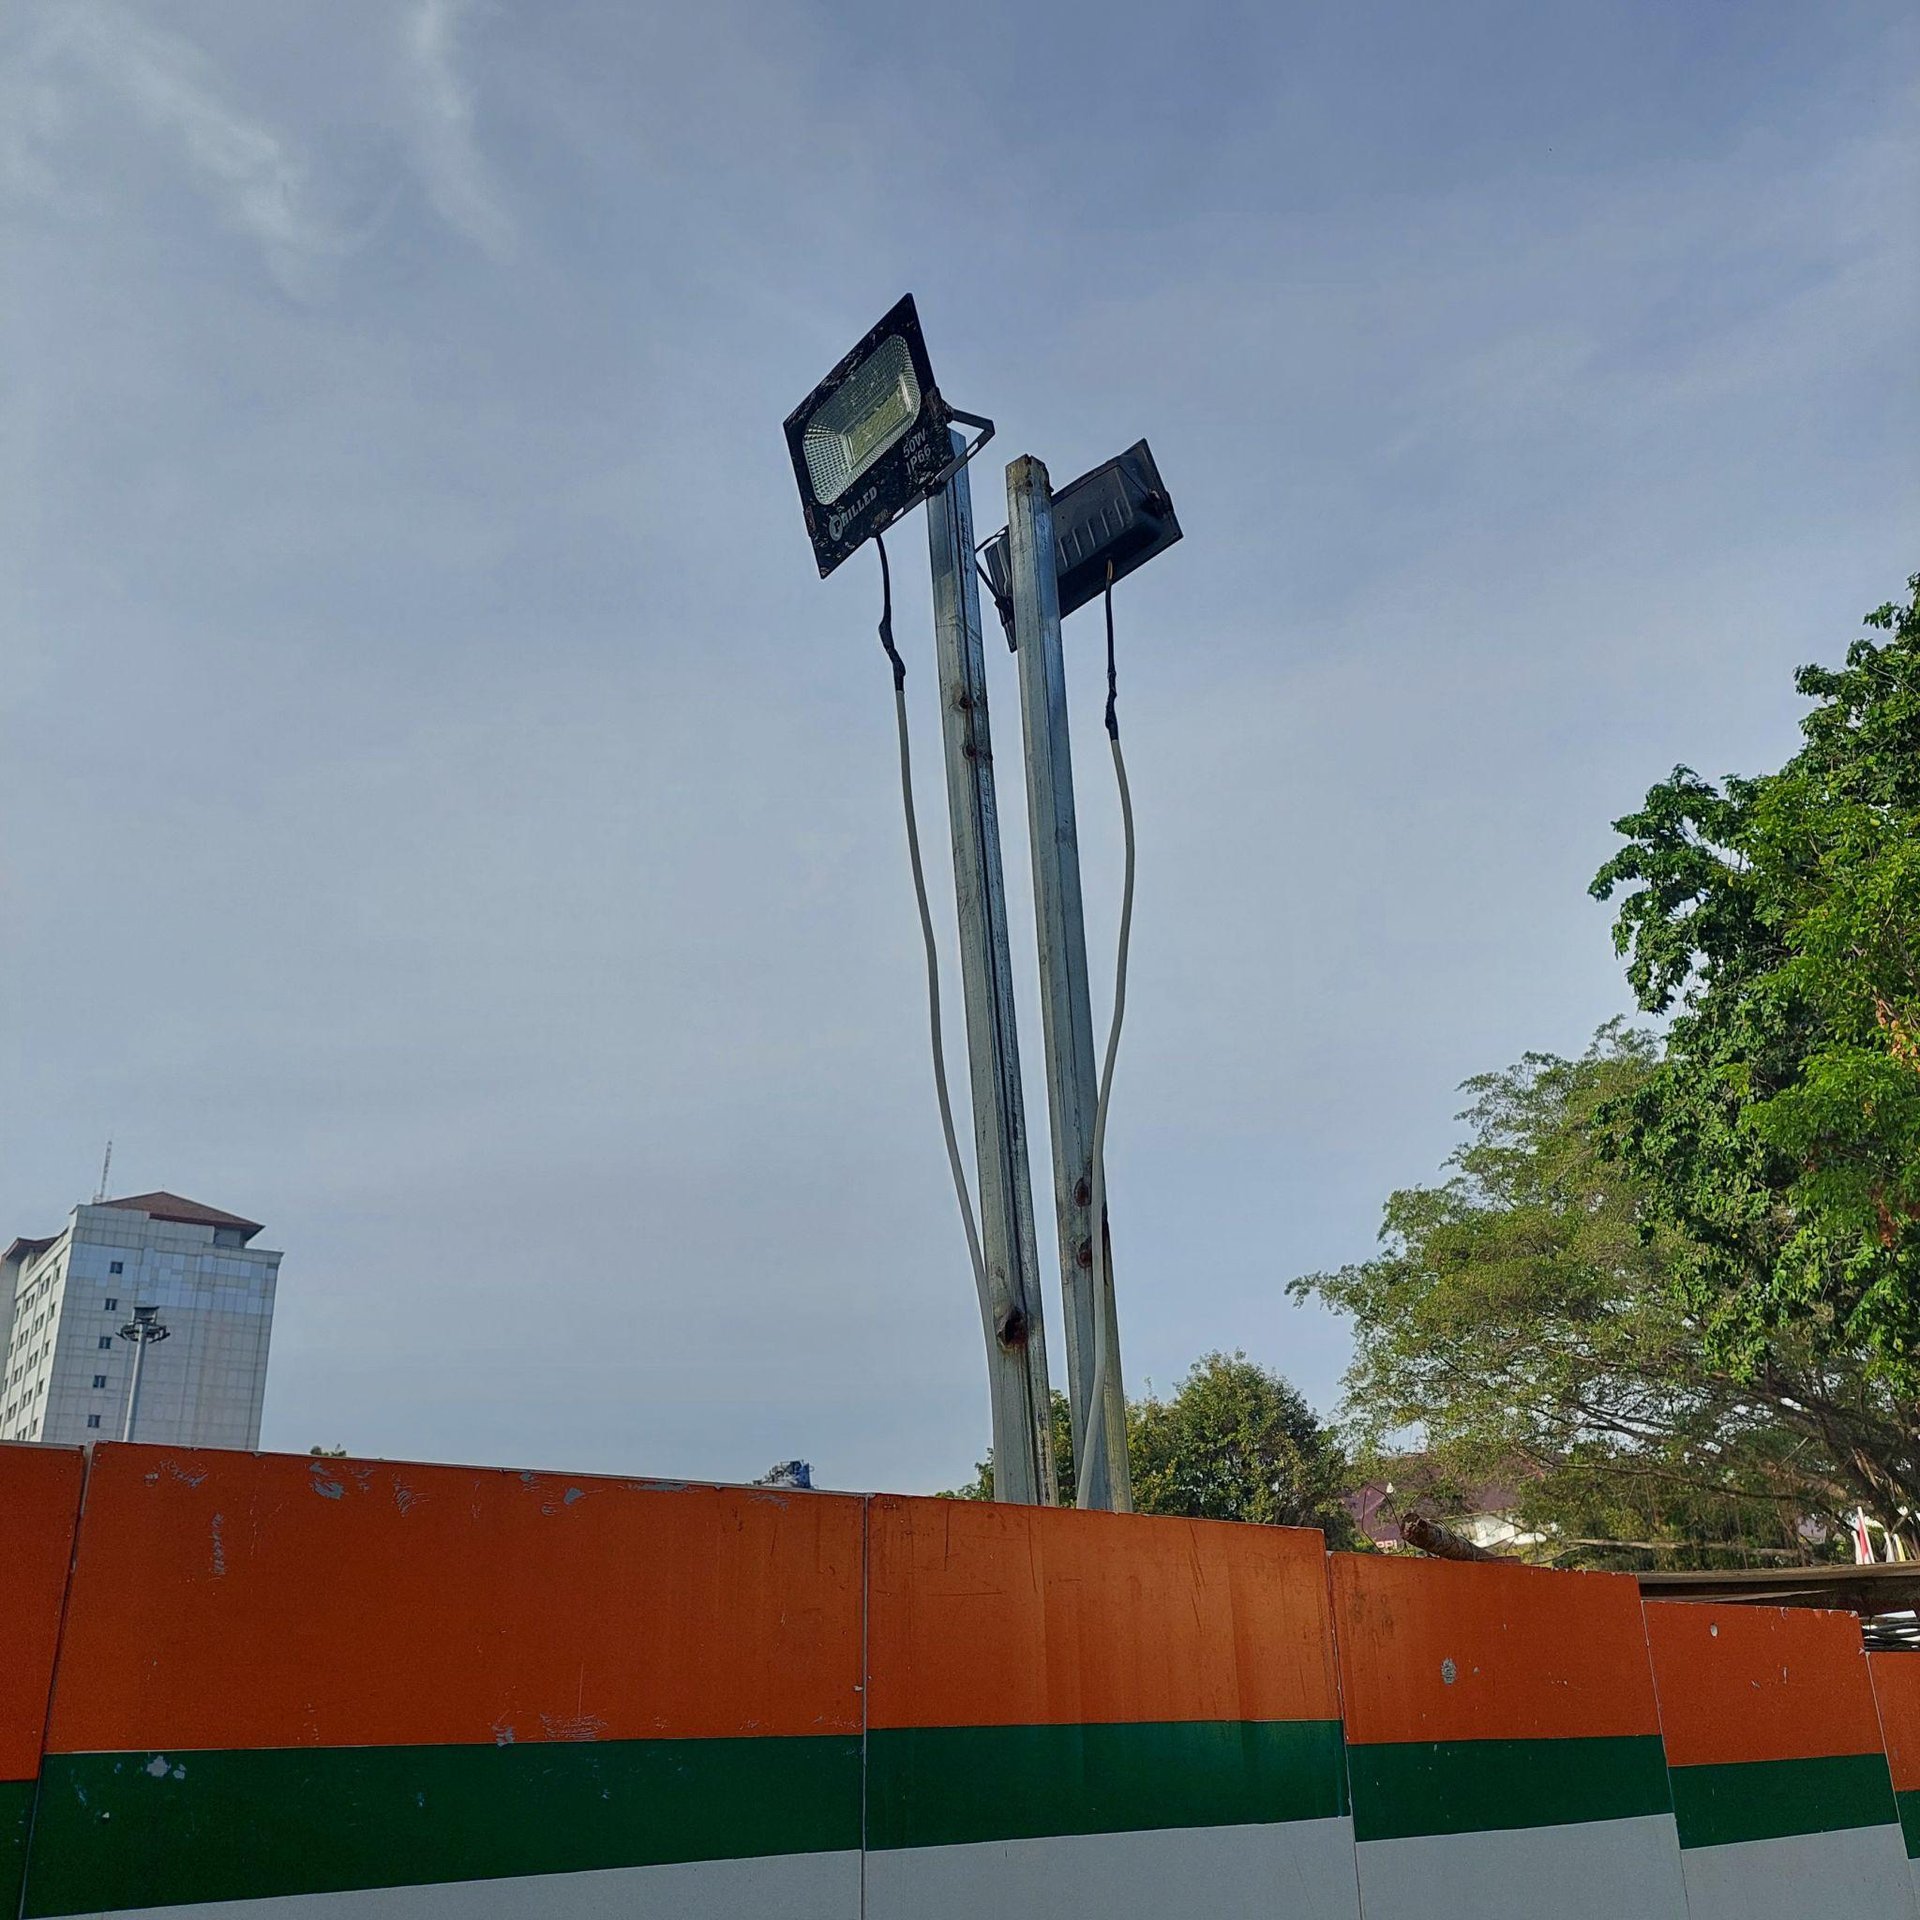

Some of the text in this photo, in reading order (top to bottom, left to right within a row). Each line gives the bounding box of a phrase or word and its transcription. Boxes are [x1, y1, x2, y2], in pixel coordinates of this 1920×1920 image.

[903, 428, 926, 458] 50W
[905, 444, 931, 476] IP66
[829, 486, 878, 541] PHILLED
